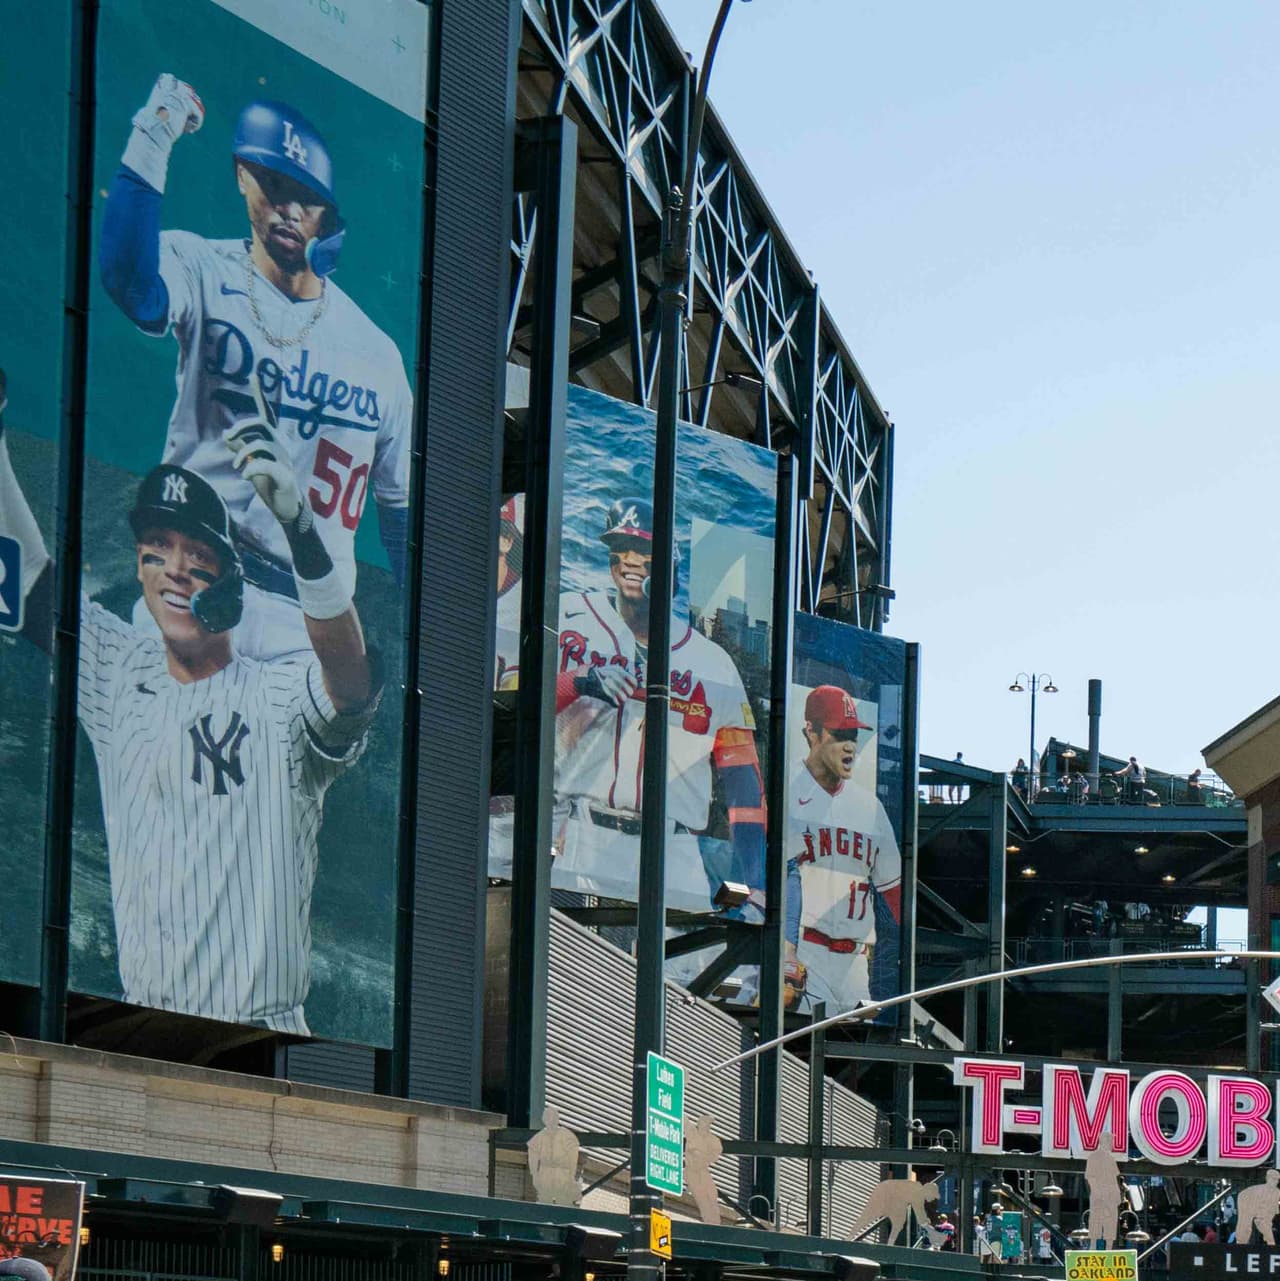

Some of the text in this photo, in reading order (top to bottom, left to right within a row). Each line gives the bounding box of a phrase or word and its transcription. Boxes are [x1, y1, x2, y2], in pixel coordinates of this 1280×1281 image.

[283, 121, 307, 166] LA
[205, 319, 380, 440] Dodgers
[162, 473, 188, 504] NY
[308, 437, 369, 531] 50
[618, 505, 640, 528] A
[189, 711, 250, 795] NY
[848, 880, 870, 920] 17
[658, 1088, 672, 1111] Field
[650, 1144, 680, 1168] DELIVERIES
[650, 1162, 680, 1186] RIGHT LANE
[1068, 1267, 1136, 1280] OAKLAND
[1077, 1255, 1127, 1268] STAY IN
